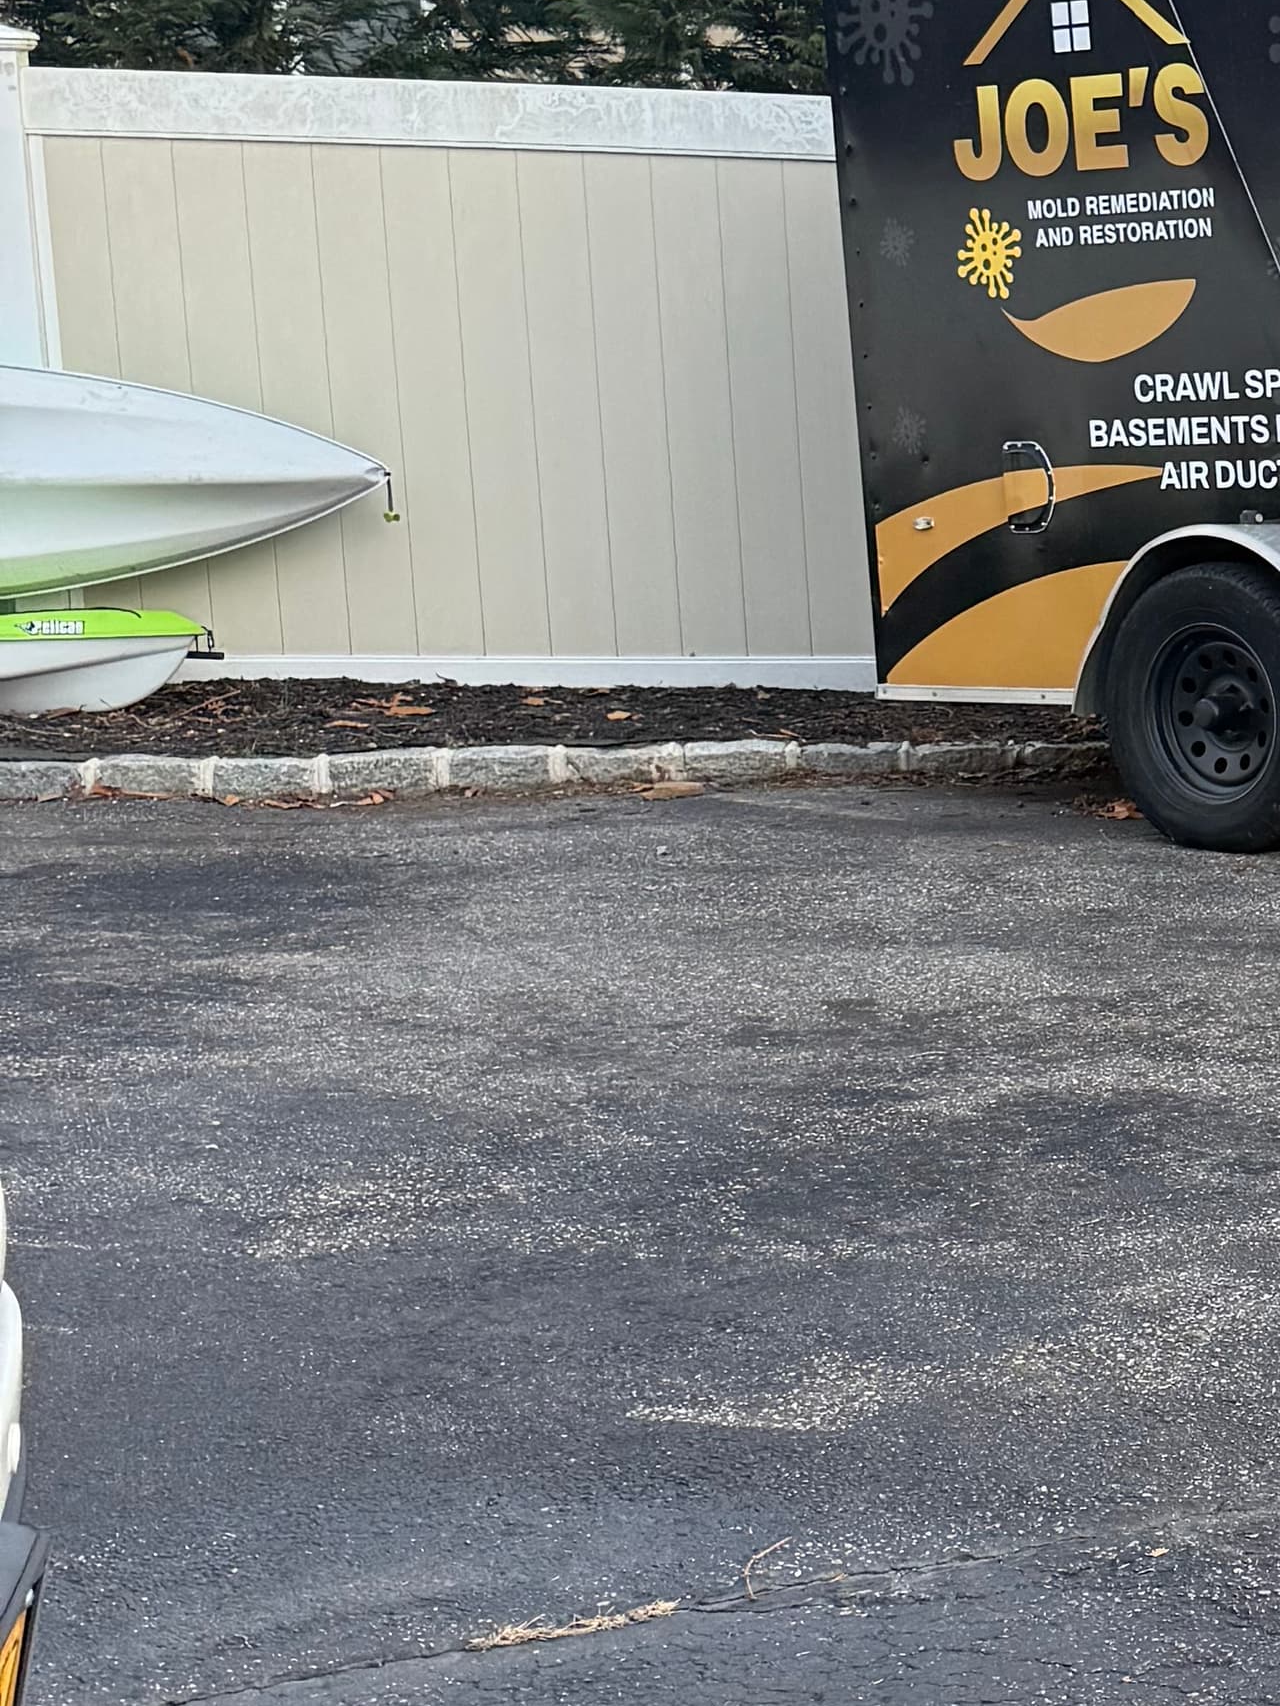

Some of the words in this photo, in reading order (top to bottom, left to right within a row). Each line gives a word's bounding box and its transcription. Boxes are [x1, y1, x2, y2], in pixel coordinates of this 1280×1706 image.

[953, 62, 1210, 181] JOE'S
[1027, 198, 1080, 220] MOLD
[1085, 187, 1216, 217] REMEDIATION
[1035, 228, 1074, 248] AND
[1078, 218, 1213, 246] RESTORATION
[1133, 370, 1240, 403] CRAWL
[1088, 414, 1271, 448] BASEMENTS
[1159, 463, 1211, 490] AIR
